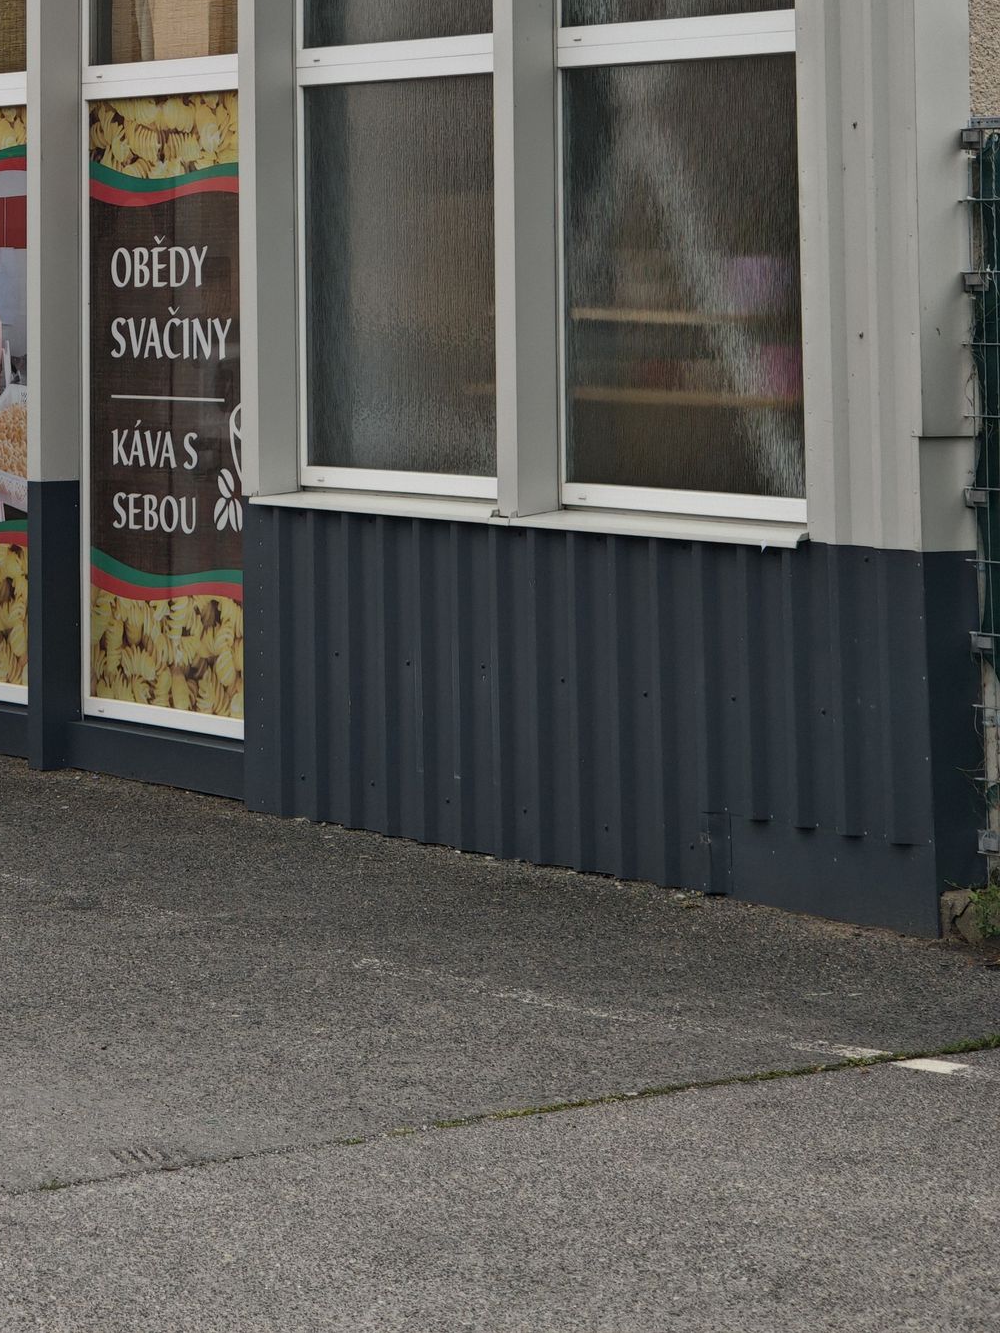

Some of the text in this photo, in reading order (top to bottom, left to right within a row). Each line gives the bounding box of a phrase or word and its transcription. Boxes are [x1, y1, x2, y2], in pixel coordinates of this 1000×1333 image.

[110, 235, 208, 289] OBĚDY
[110, 306, 232, 361] SVAČINY
[111, 419, 198, 470] KÁVA S
[112, 491, 197, 534] SEBOU
